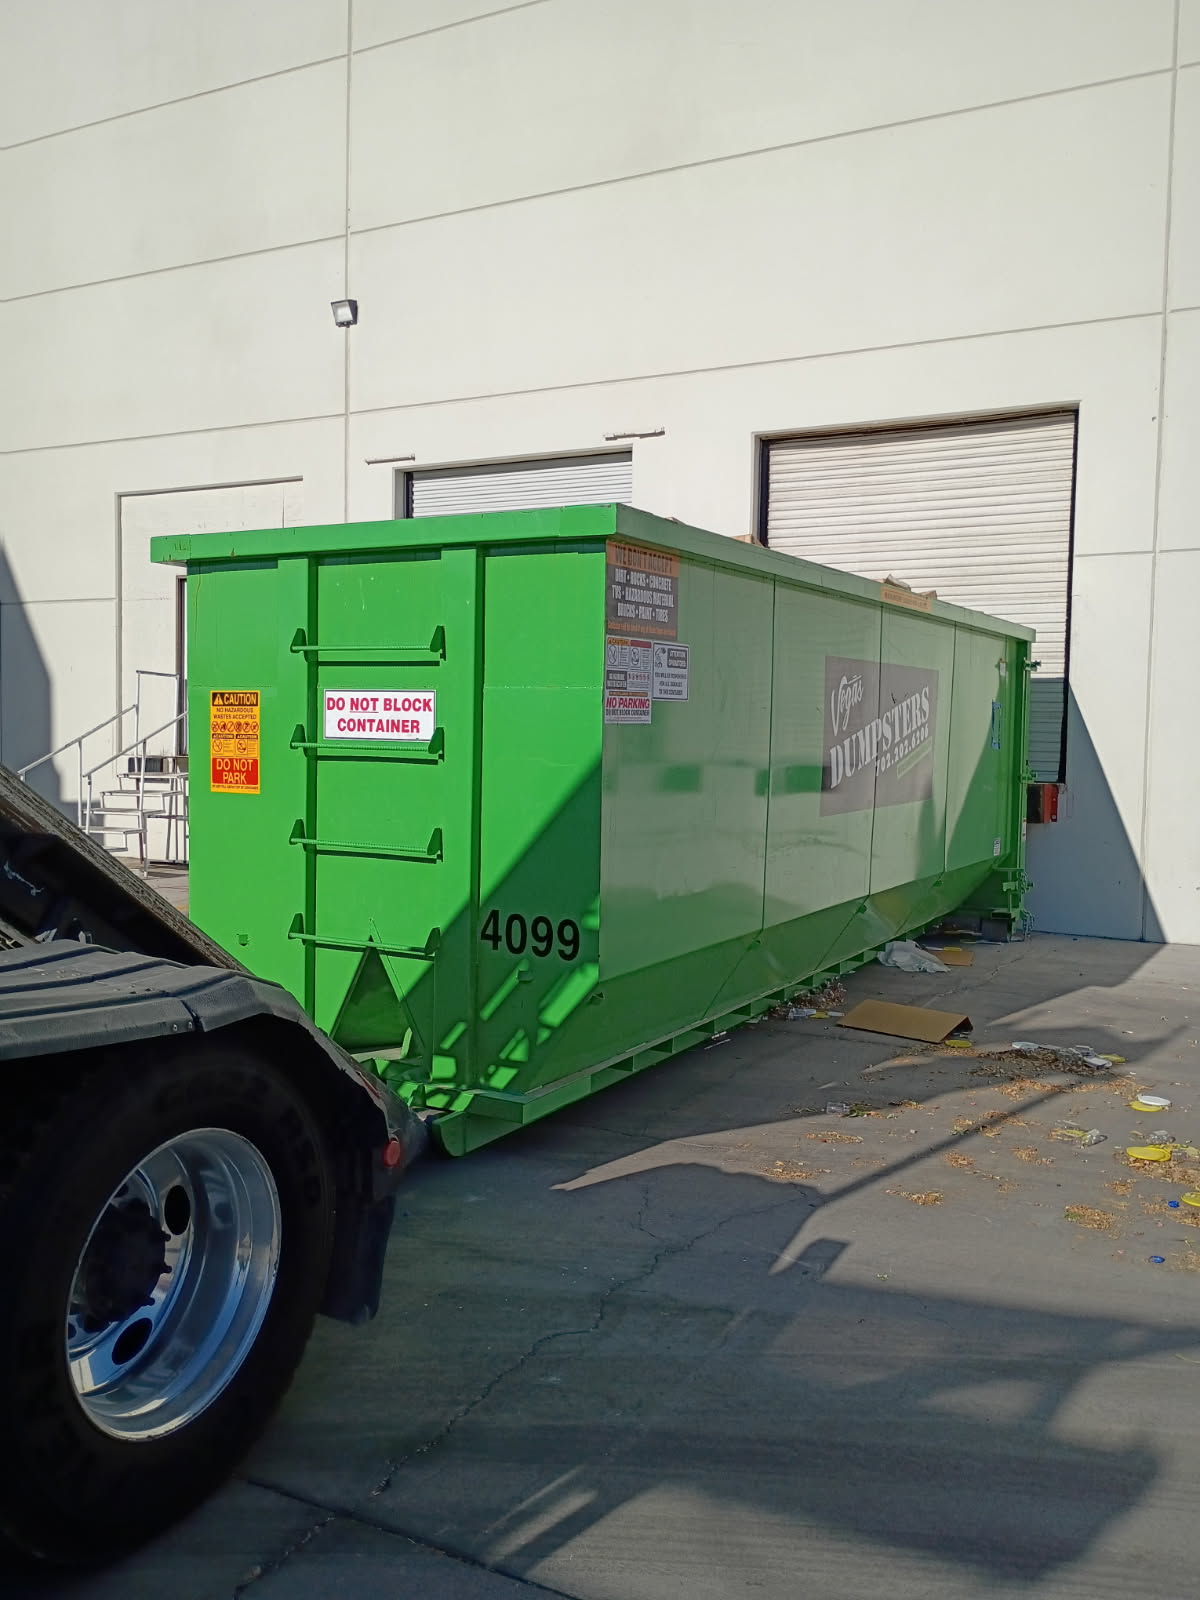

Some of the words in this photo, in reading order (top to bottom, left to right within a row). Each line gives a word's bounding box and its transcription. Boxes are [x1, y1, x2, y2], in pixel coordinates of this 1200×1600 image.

[615, 568, 627, 583] DIRT
[630, 571, 646, 587] ROCKS
[649, 575, 672, 591] CONCRETE
[612, 584, 622, 599] TVS
[625, 587, 653, 604] HAZARDOUS
[653, 592, 674, 608] MATERIAL
[617, 602, 636, 618] BRICKS
[638, 606, 652, 620] PAINT
[223, 693, 257, 705] CAUTION
[326, 697, 345, 711] DO
[350, 697, 379, 711] NOT
[383, 698, 433, 712] BLOCK
[606, 697, 617, 708] NO
[618, 698, 650, 709] PARKING
[831, 673, 864, 737] Vegas
[337, 717, 420, 733] CONTAINER
[829, 686, 930, 789] DUMPSTERS
[216, 758, 231, 771] DO
[233, 759, 253, 771] NOT
[222, 772, 247, 785] PARK
[480, 909, 580, 962] 4099
